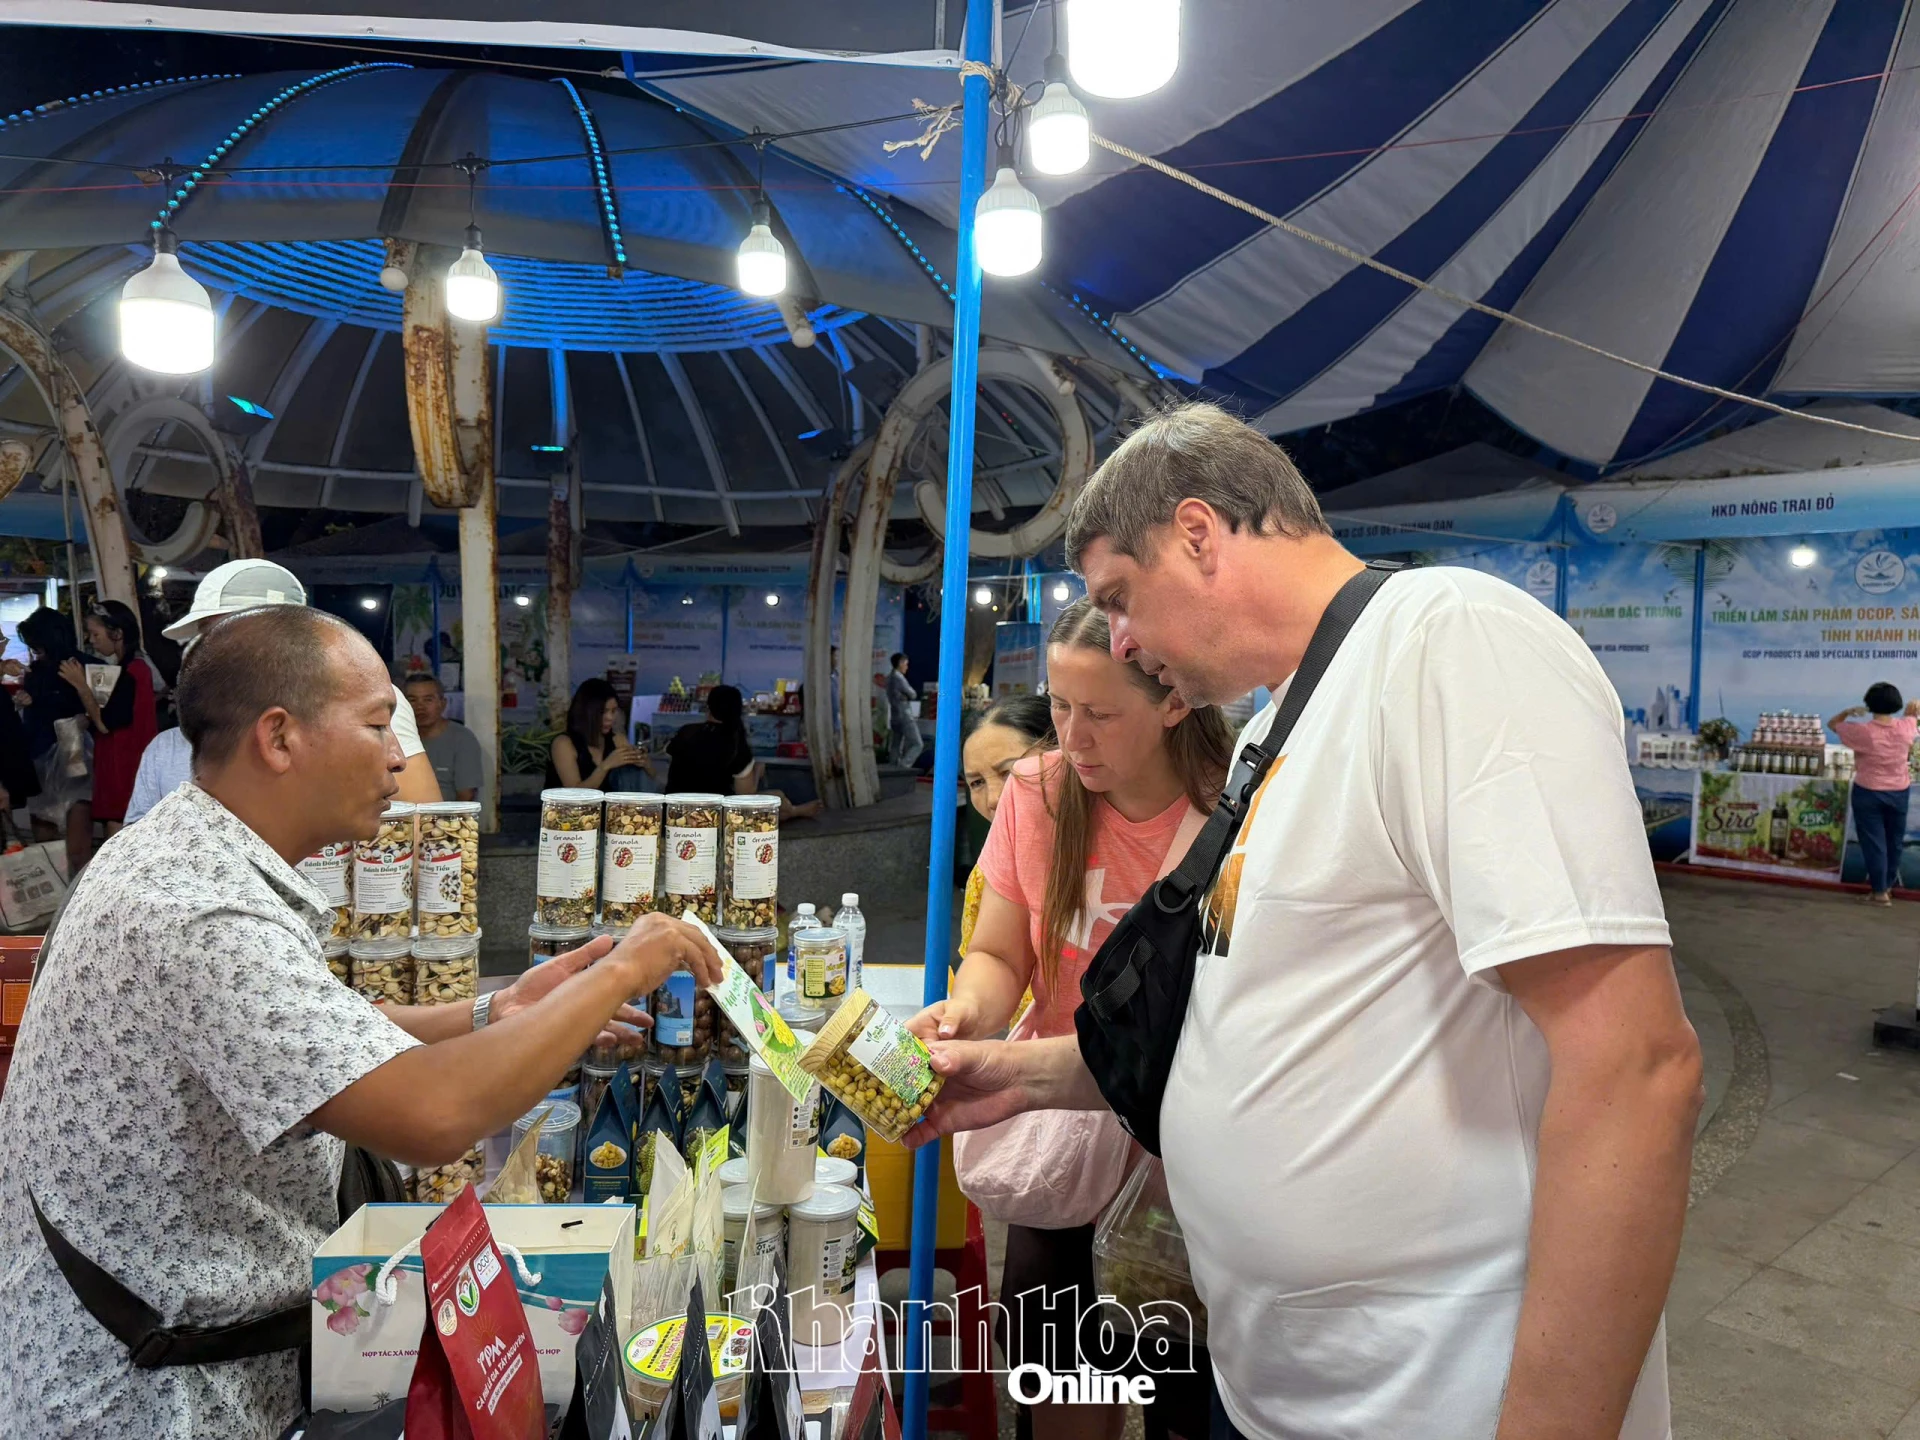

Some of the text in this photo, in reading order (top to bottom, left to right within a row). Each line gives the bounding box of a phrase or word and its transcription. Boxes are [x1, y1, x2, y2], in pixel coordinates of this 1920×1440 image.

[1712, 492, 1834, 518] HKD NÔNG TRẠI ĐỎ
[1812, 604, 1852, 620] PHẨM
[1855, 626, 1903, 642] KHÁNH
[1764, 650, 1802, 659] PRODUCTS
[1804, 650, 1820, 658] AND
[1822, 650, 1870, 659] SPECIALTIES
[1872, 650, 1918, 658] EXHIBITION
[1800, 812, 1826, 826] 25K
[362, 1350, 378, 1358] HỢP
